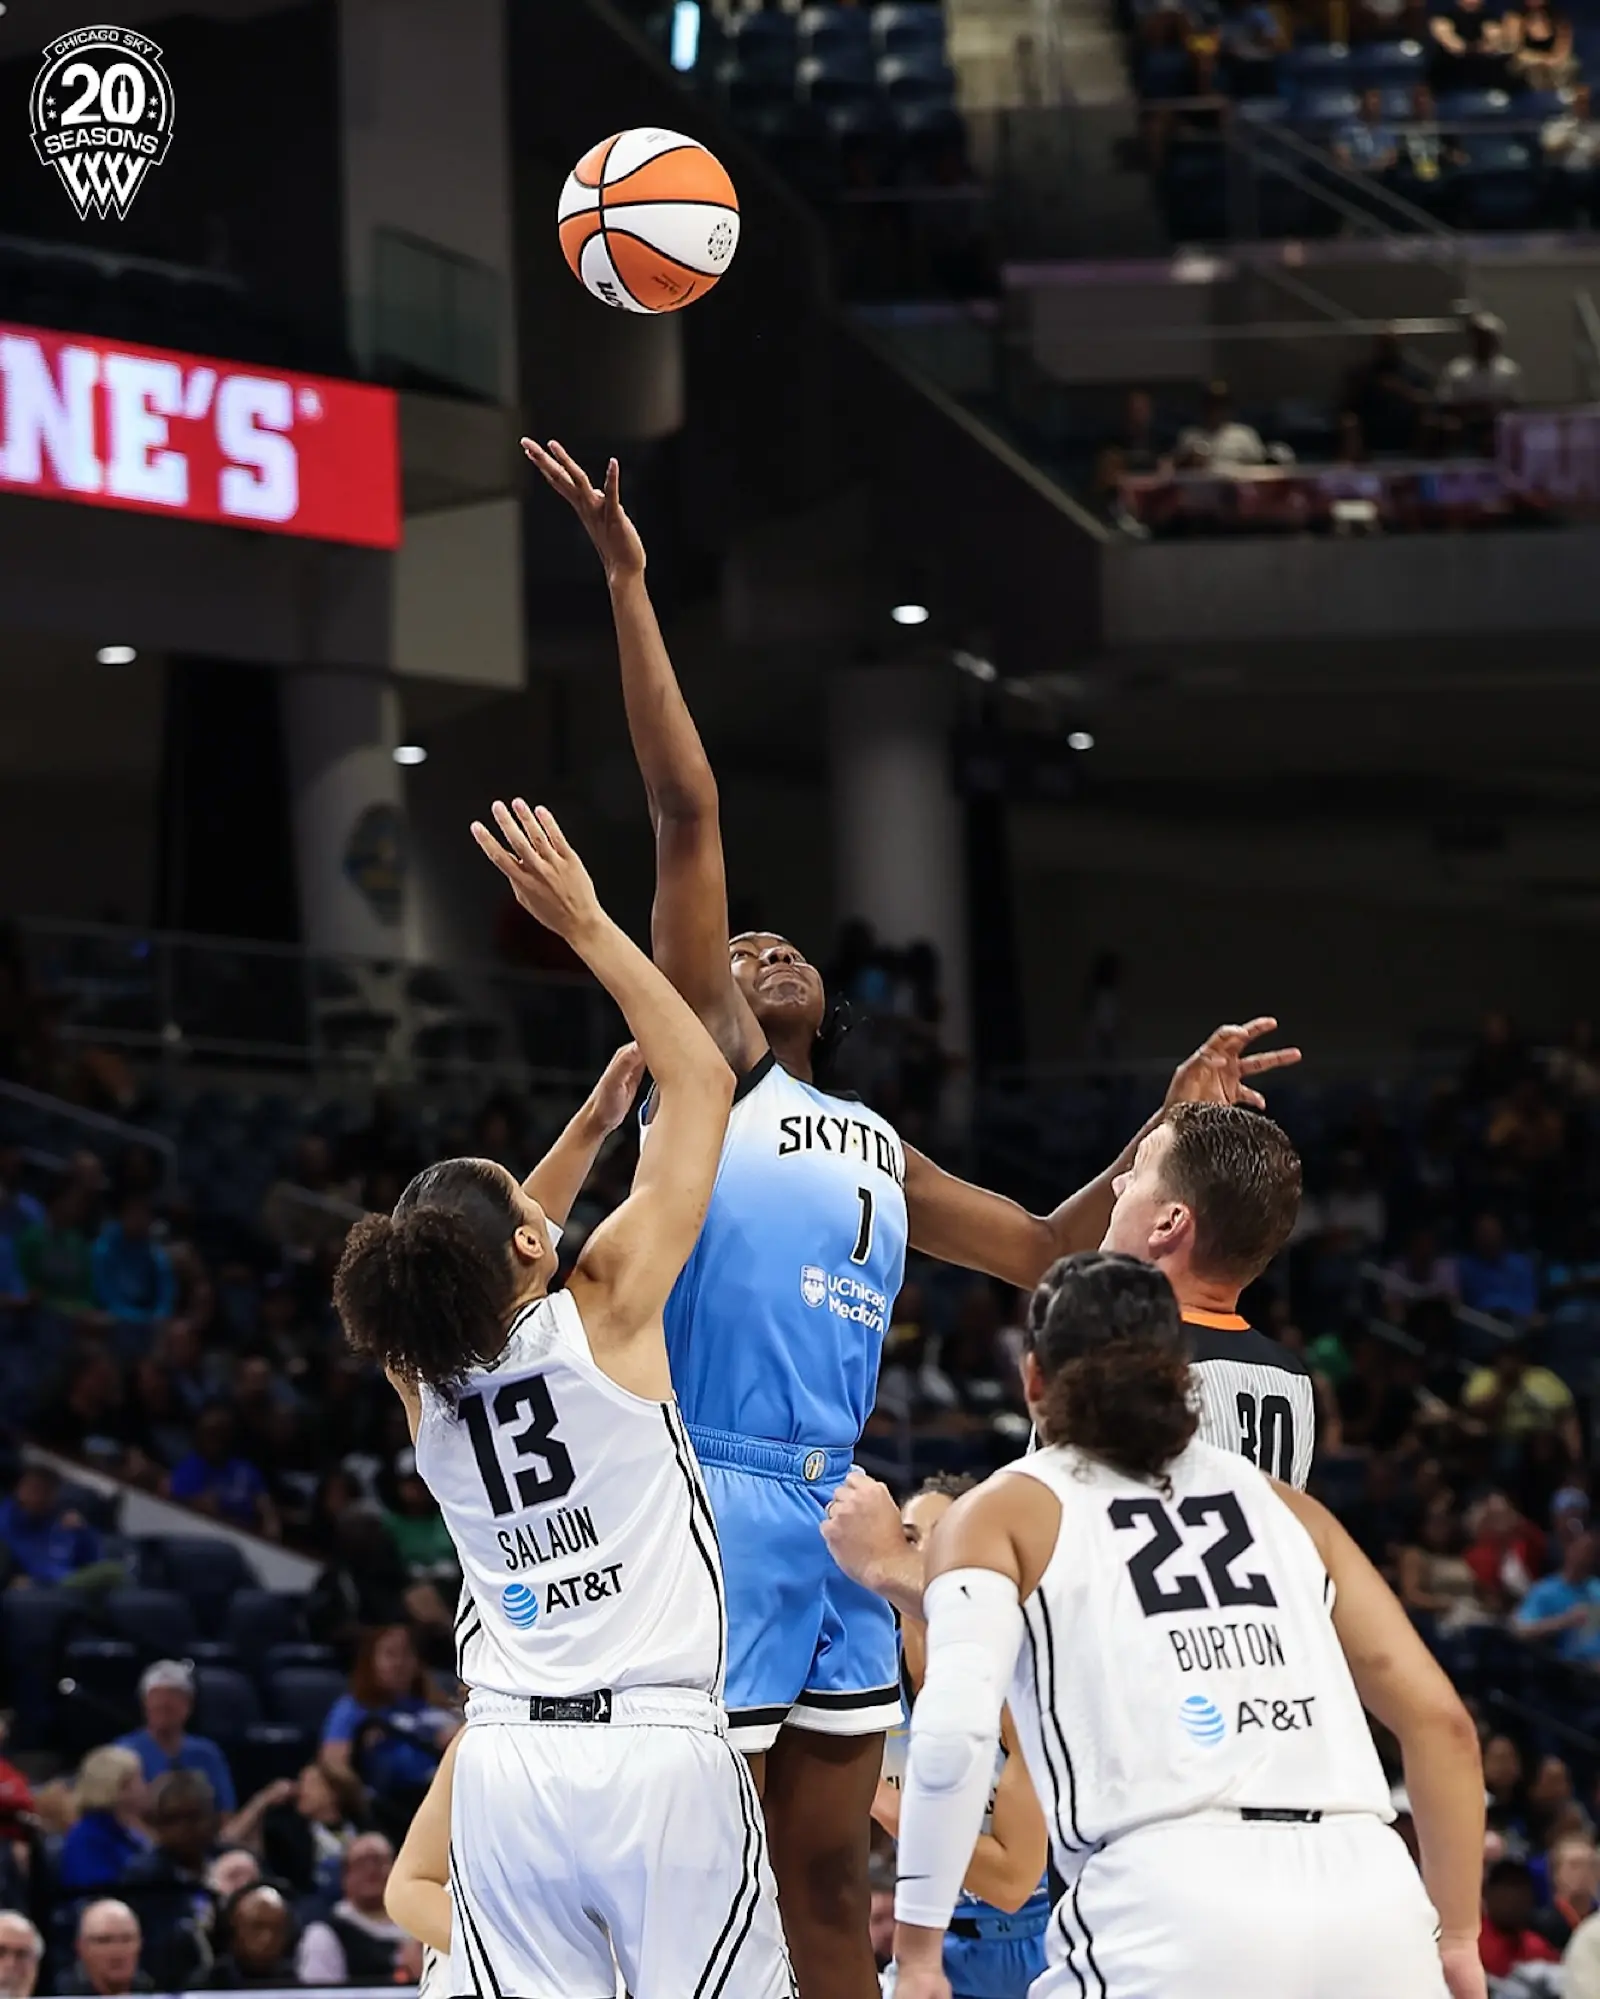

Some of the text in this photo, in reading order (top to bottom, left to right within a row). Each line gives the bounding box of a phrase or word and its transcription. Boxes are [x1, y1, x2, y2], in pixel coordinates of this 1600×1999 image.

[850, 1184, 873, 1265] 1
[457, 1372, 576, 1519] 13
[497, 1505, 599, 1571] SALAÜN
[1107, 1490, 1278, 1619] 22
[545, 1563, 623, 1614] AT&T
[1168, 1622, 1286, 1672] BURTON
